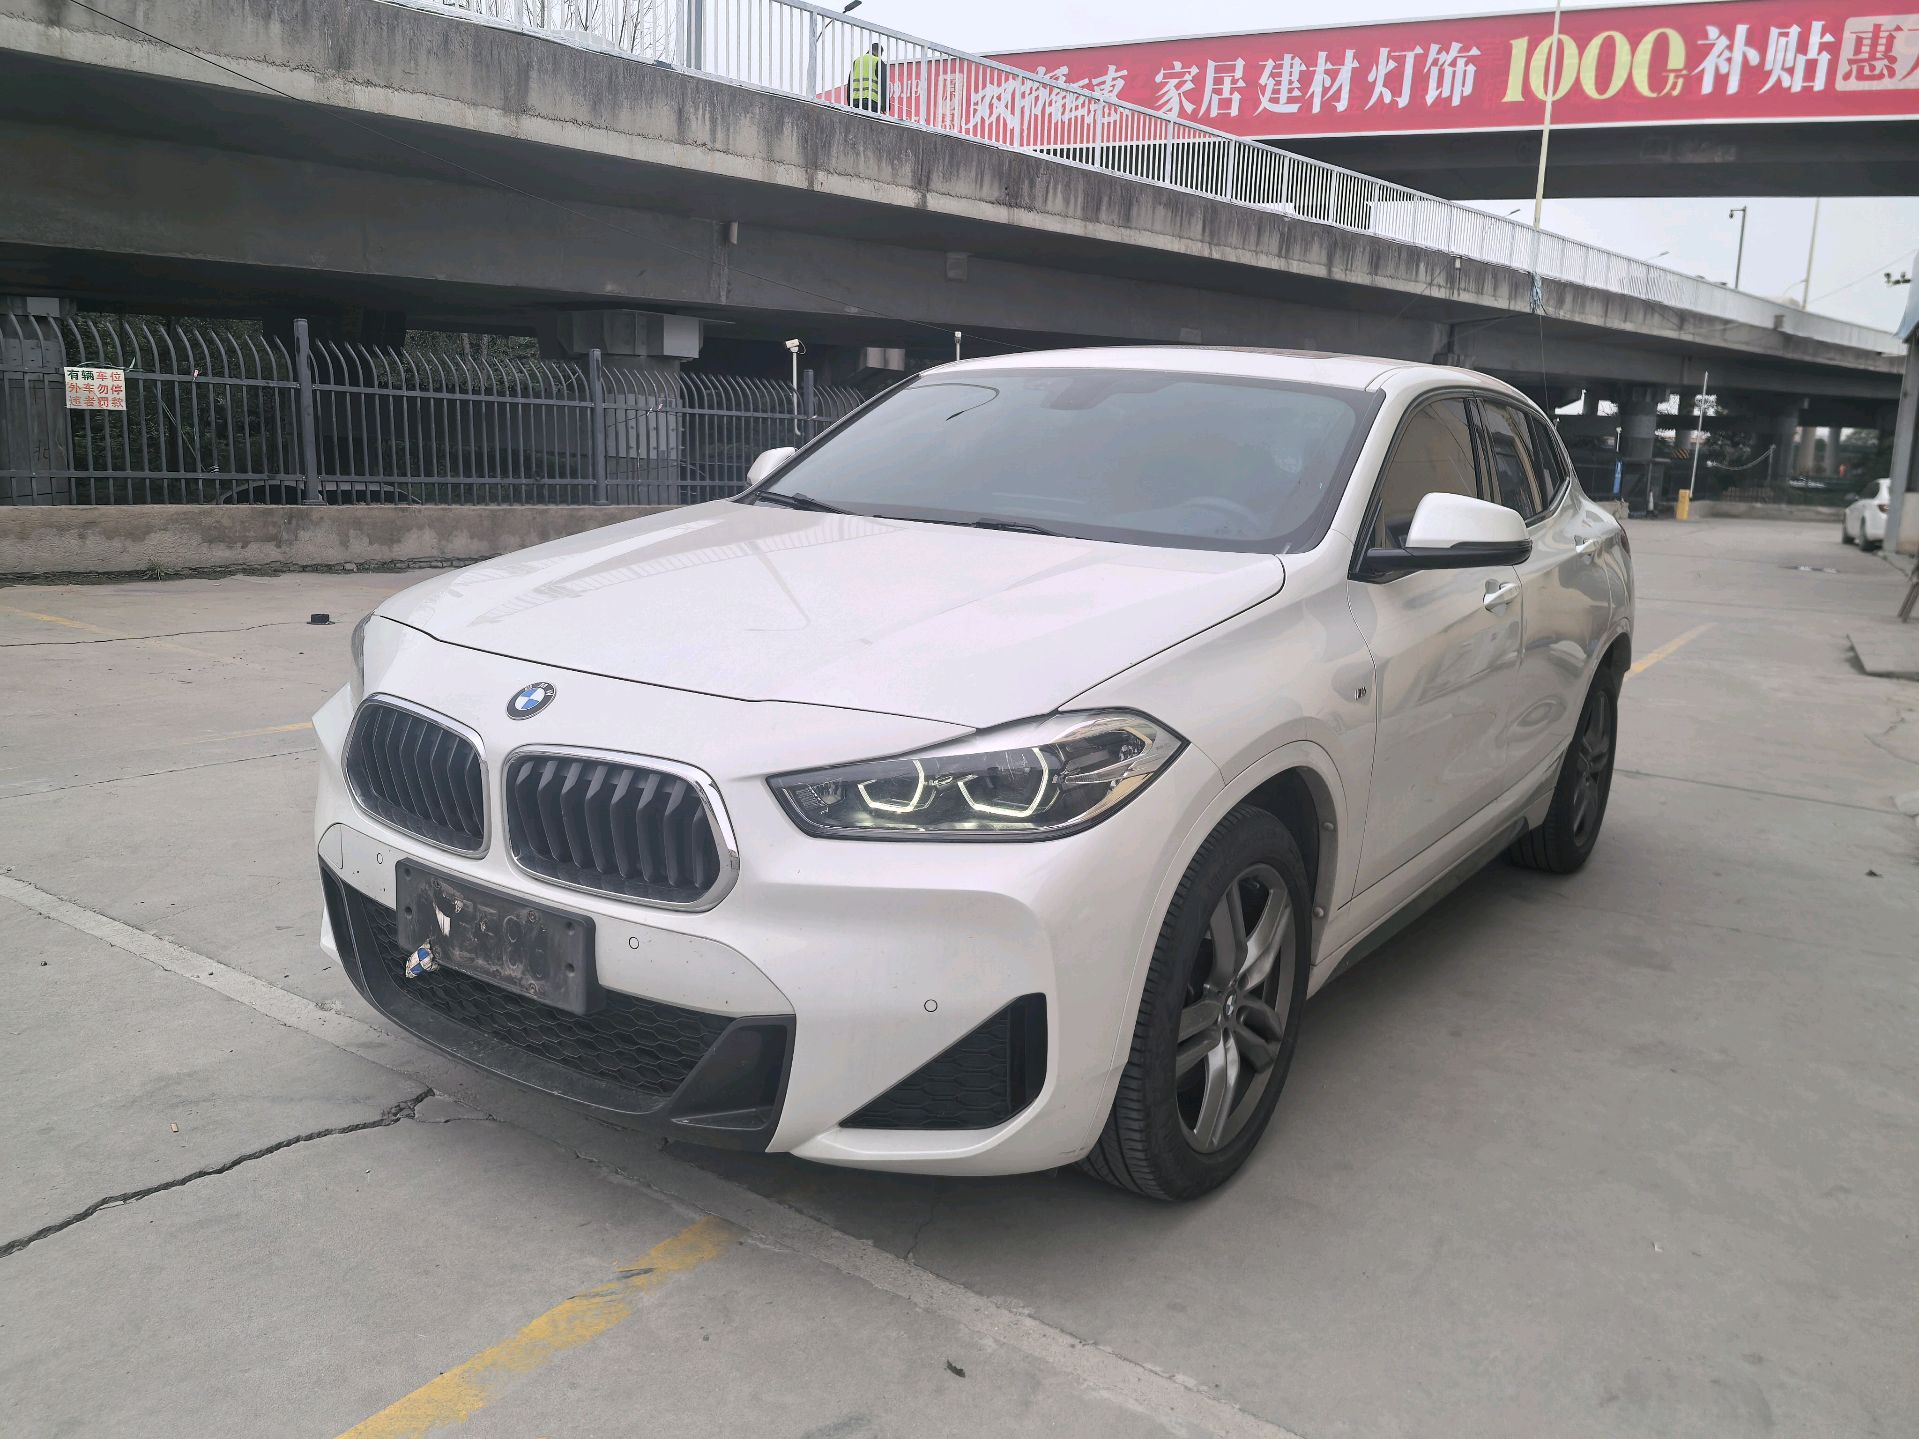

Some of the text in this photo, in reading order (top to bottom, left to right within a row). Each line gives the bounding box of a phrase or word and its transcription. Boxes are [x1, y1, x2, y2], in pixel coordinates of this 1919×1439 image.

[67, 369, 122, 382] 有辆车位
[68, 382, 123, 395] 外车勿停
[69, 396, 123, 408] 违者罚款
